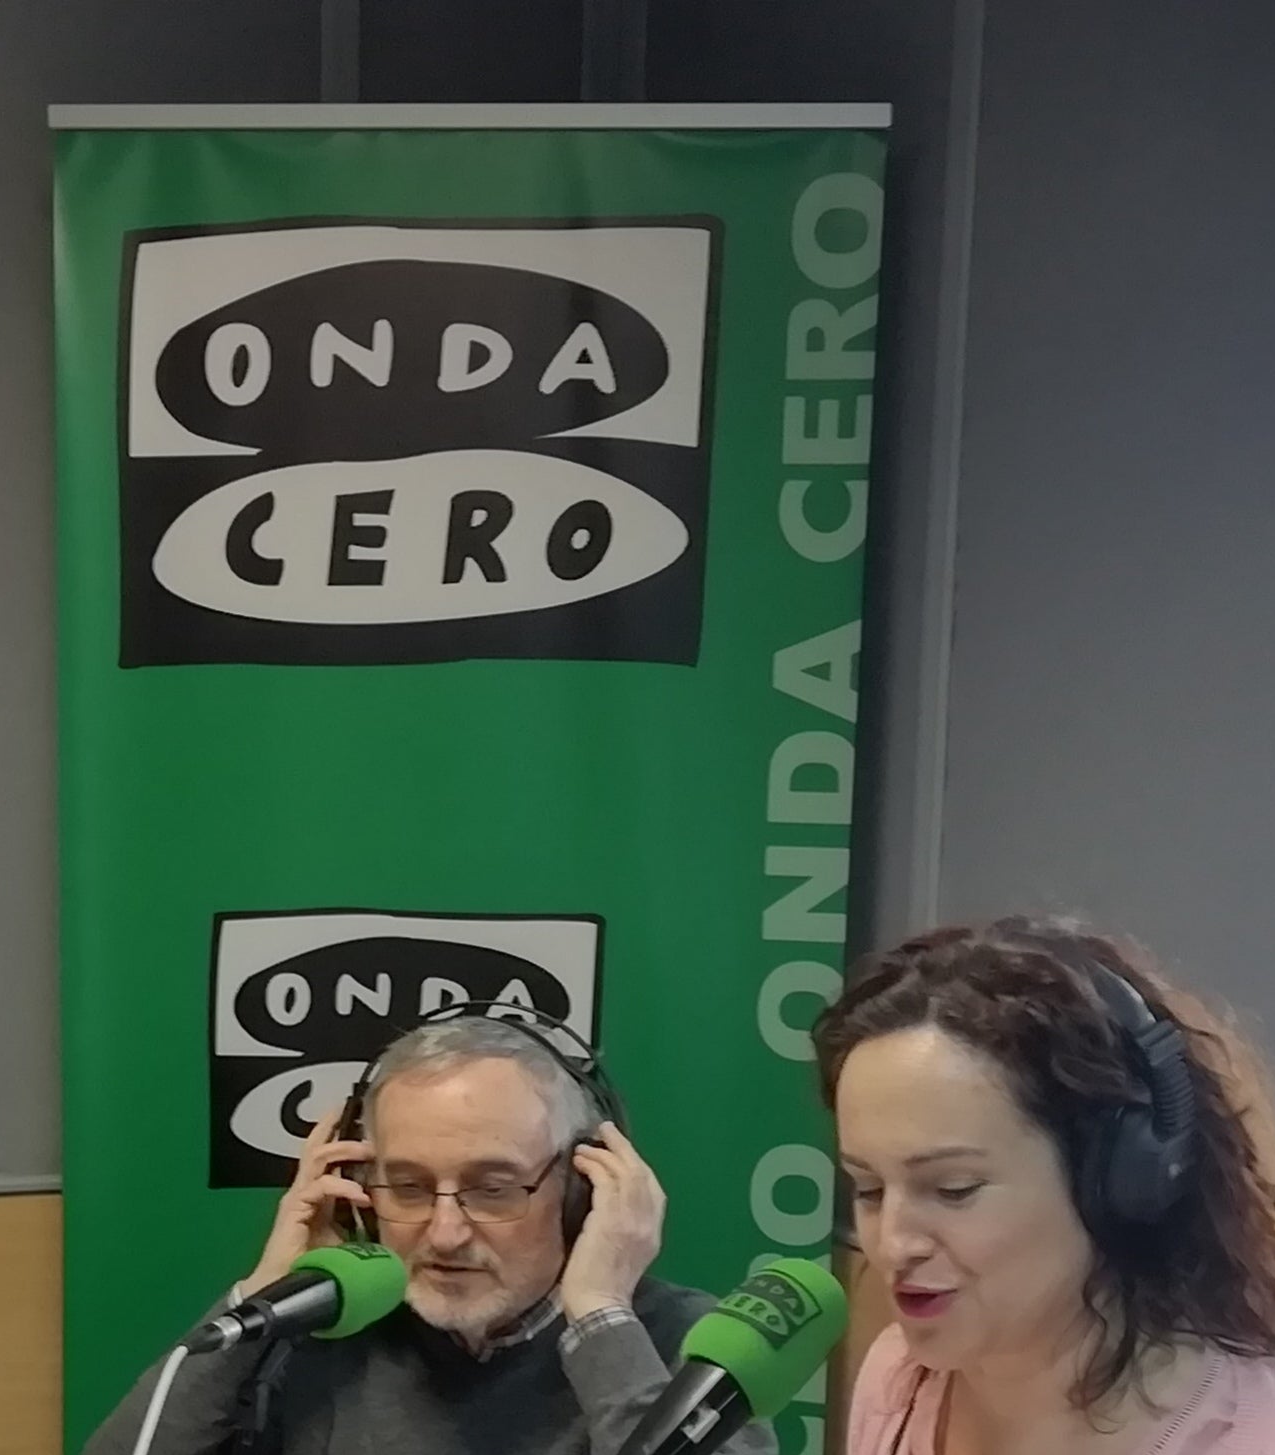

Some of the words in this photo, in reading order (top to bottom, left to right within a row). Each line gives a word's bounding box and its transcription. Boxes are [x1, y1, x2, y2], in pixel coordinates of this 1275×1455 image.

[204, 318, 617, 407] ONDA
[777, 172, 886, 564] CERO
[225, 488, 613, 586] CERO
[756, 618, 862, 1063] ONDA
[265, 972, 538, 1027] ONDA
